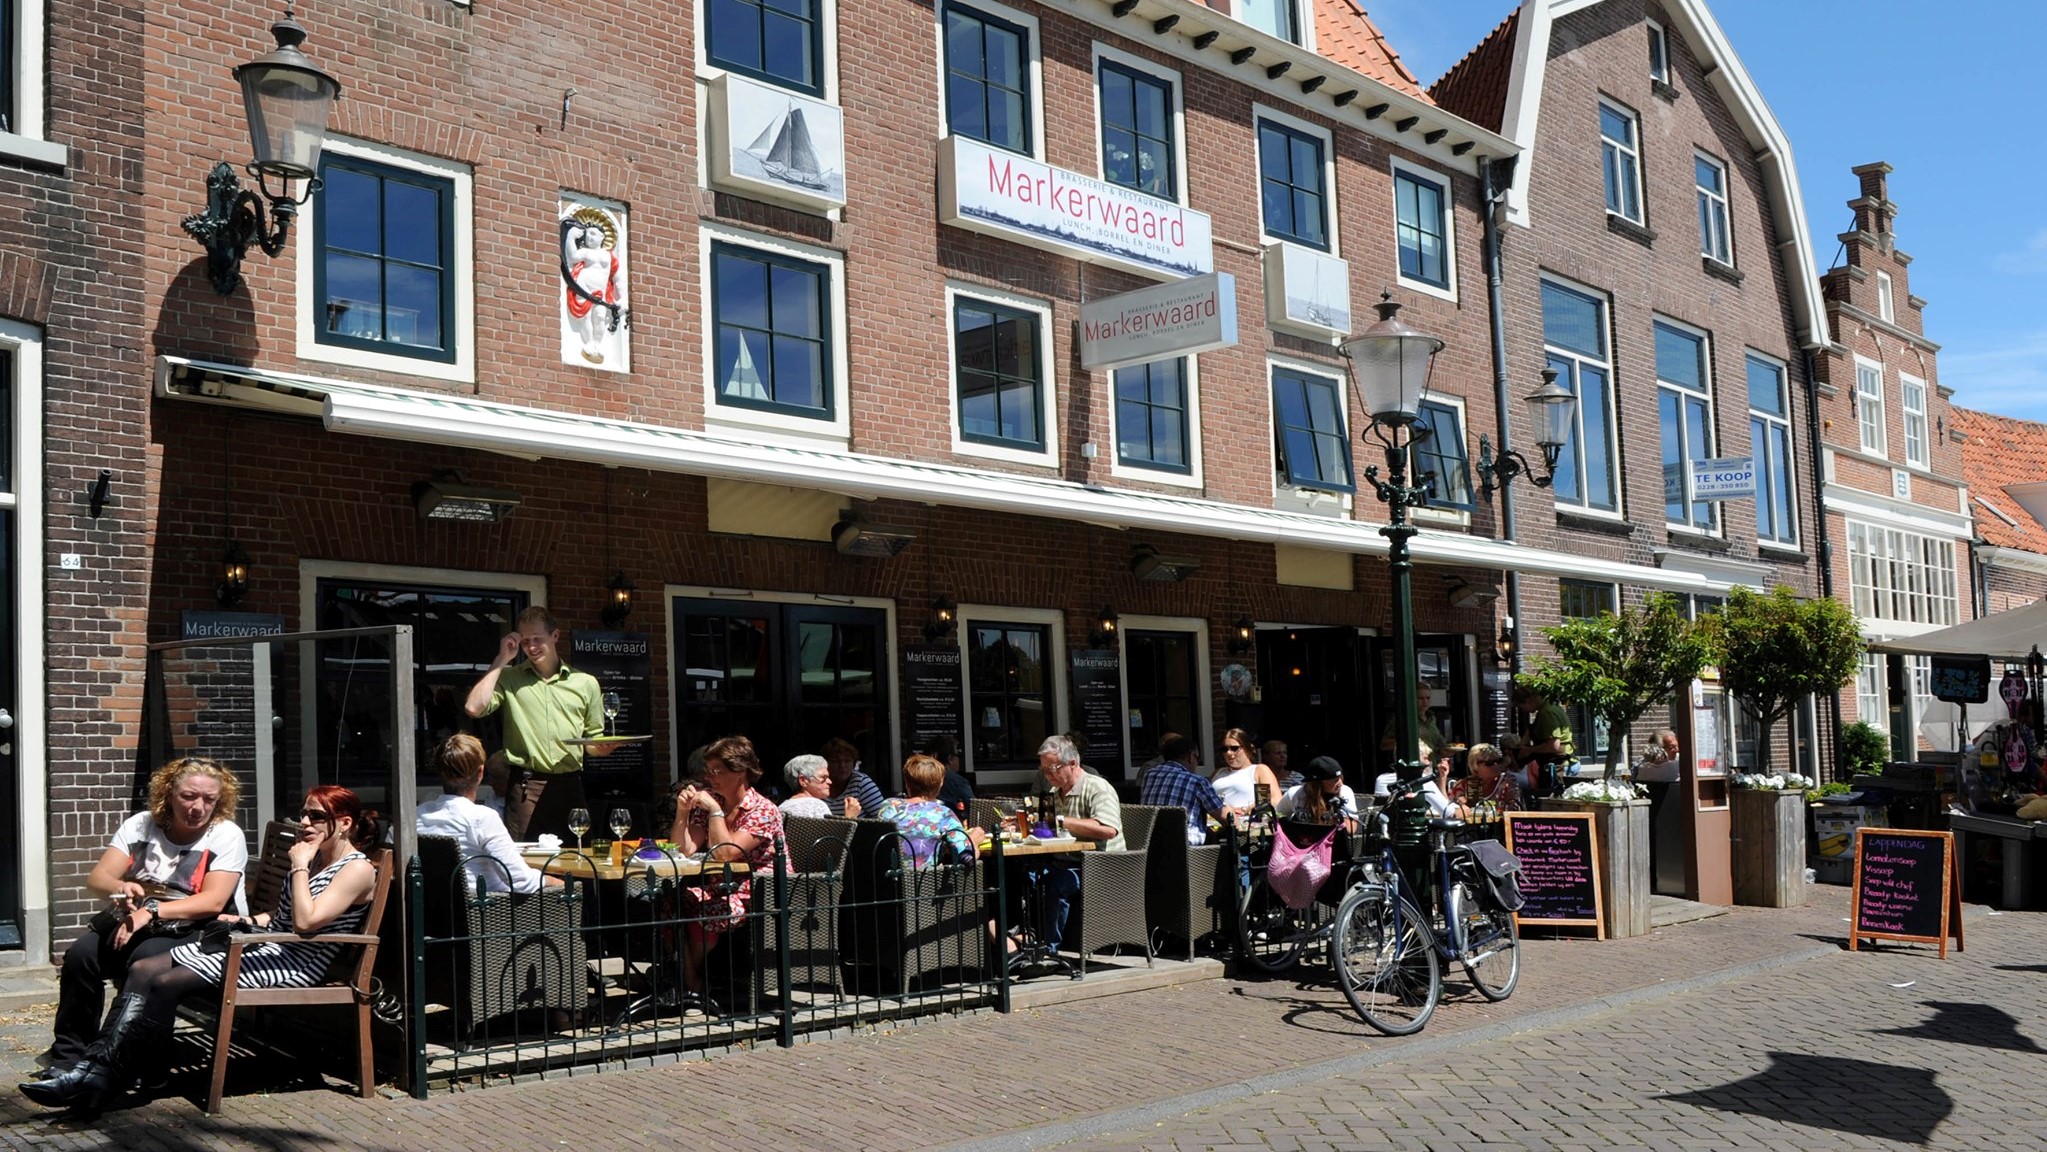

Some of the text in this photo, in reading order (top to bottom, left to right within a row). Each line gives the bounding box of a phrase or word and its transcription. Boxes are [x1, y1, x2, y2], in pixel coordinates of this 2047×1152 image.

[1060, 171, 1105, 193] BRASSERIE
[1118, 189, 1169, 212] RESTAURANT
[988, 153, 1185, 248] Markerwaard
[1098, 227, 1130, 244] BORREL
[1133, 238, 1144, 247] EN
[1146, 242, 1171, 254] DINER
[1084, 290, 1216, 342] Markerwaard
[1695, 472, 1752, 483] TE KOOP
[186, 621, 282, 637] Markerwaard
[575, 639, 647, 653] Markerwaard
[906, 651, 960, 664] Markerwaard
[1073, 657, 1119, 668] Markerwaard
